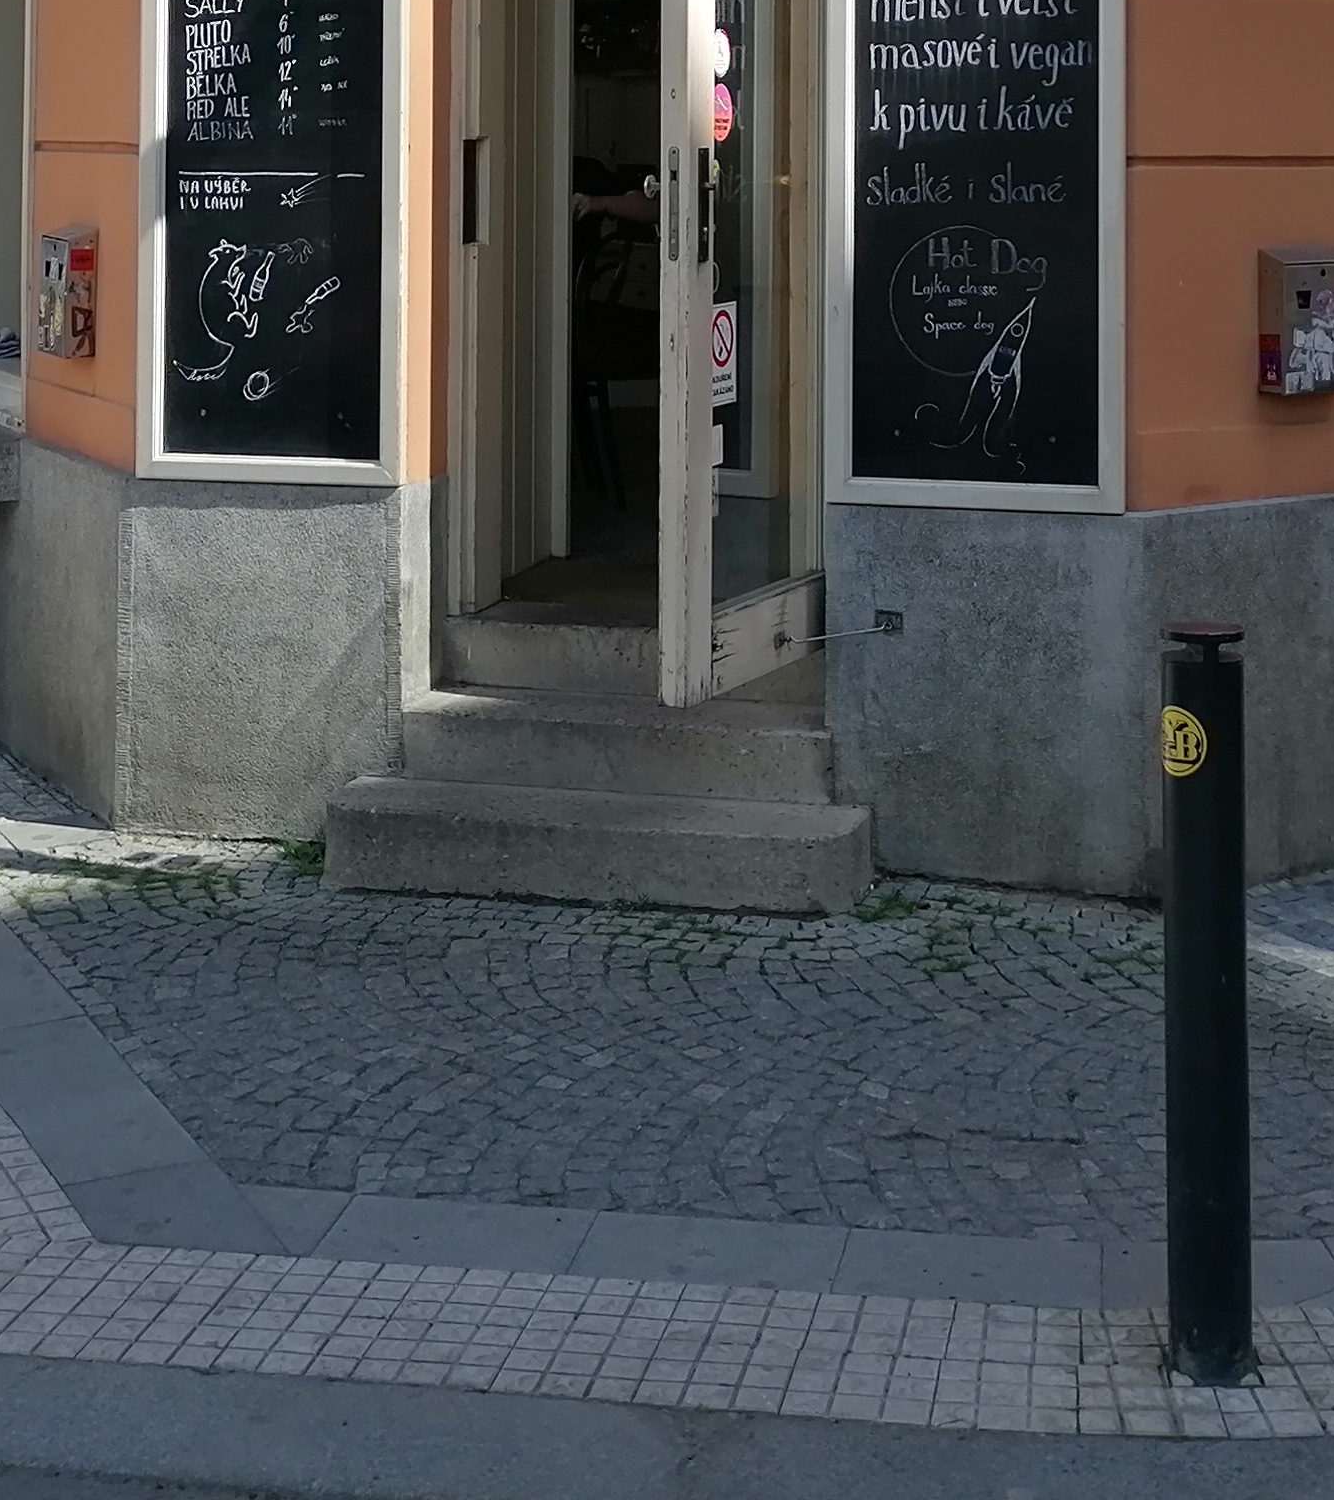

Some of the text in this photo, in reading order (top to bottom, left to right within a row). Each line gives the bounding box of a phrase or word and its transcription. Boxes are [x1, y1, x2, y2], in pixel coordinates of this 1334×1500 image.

[185, 19, 232, 52] PLUTO
[186, 43, 252, 75] STRELKA
[870, 33, 1093, 87] masové i vegan
[187, 98, 215, 121] RED
[224, 96, 251, 118] ALE
[870, 85, 1075, 150] k pivu i kávě
[187, 120, 254, 141] ALBINA
[179, 179, 199, 194] NA
[968, 177, 976, 200] i
[205, 196, 244, 210] LAHVI
[928, 237, 1048, 292] Hot Dog
[912, 273, 951, 303] Lajka
[923, 311, 995, 340] Space dog
